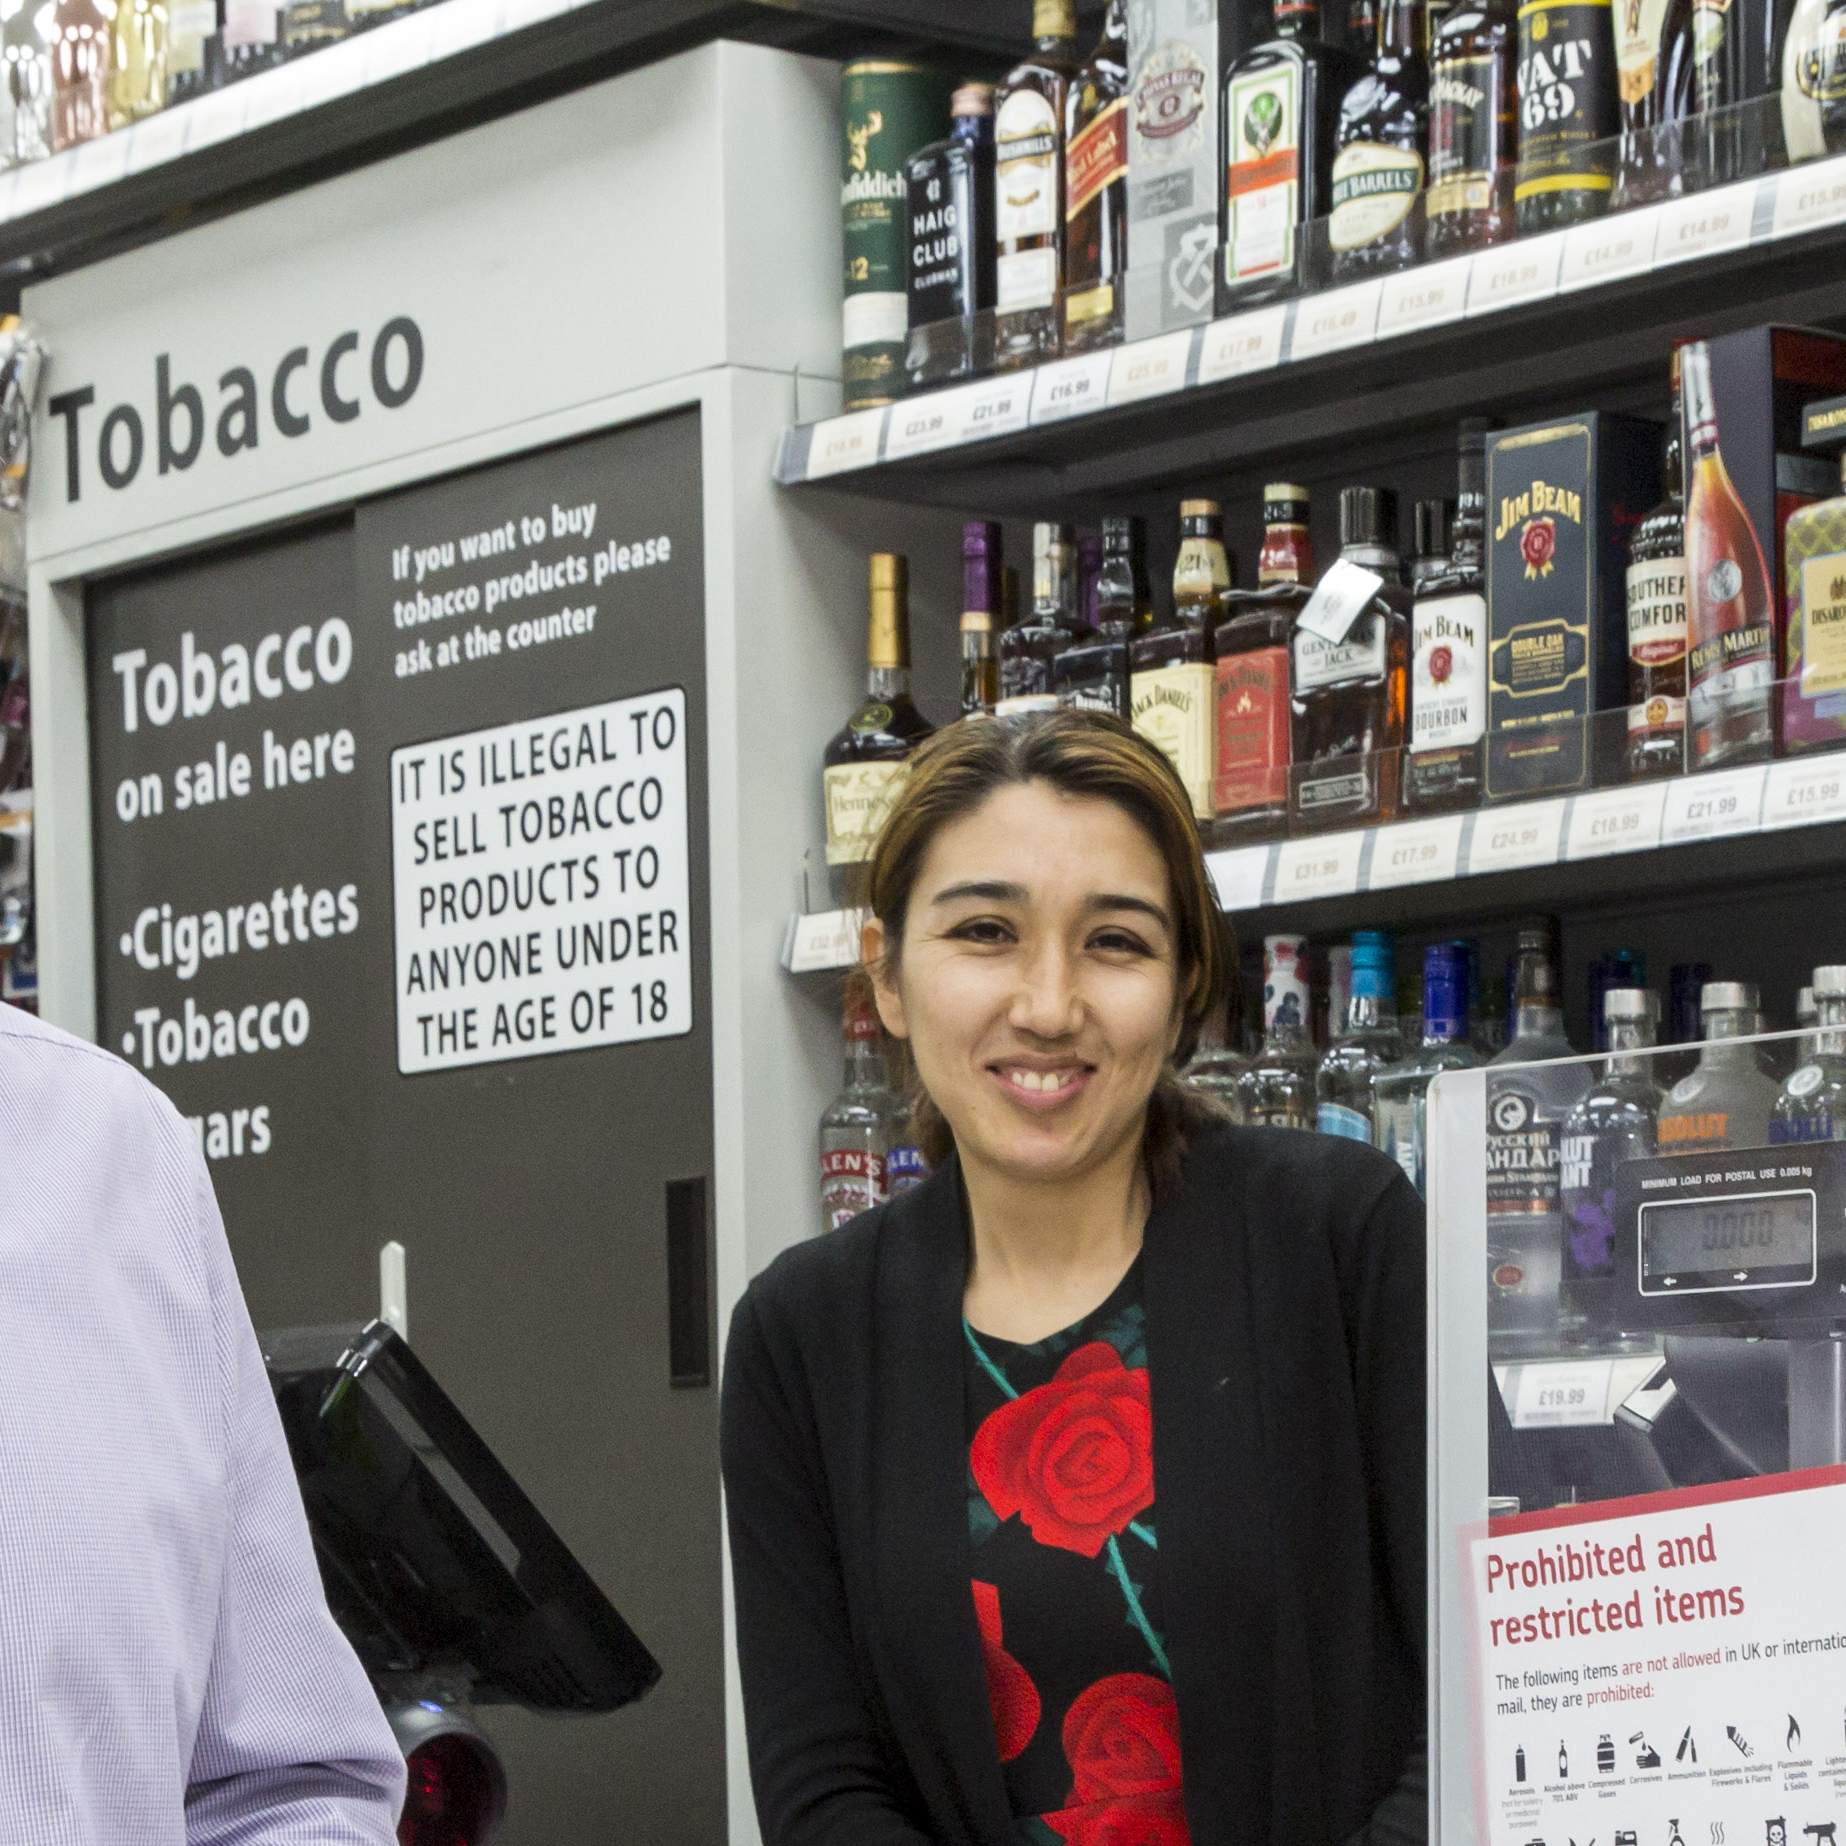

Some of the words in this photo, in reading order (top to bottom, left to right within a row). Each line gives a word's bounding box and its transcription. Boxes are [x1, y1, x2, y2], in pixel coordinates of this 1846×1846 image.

[1522, 82, 1576, 131] 69
[1349, 167, 1412, 192] BARRELS
[913, 206, 955, 235] HAIG
[913, 237, 957, 266] CLUB
[48, 315, 425, 502] Tobacco
[392, 548, 409, 579] If
[415, 536, 454, 581] you
[460, 524, 515, 567] want
[522, 515, 546, 544] to
[552, 501, 596, 541] buy
[1494, 492, 1529, 541] JIM
[1531, 480, 1581, 523] BEAM
[394, 584, 480, 627] tobacco
[485, 556, 588, 611] products
[595, 532, 671, 583] please
[395, 646, 432, 677] ask
[438, 643, 459, 665] at
[465, 630, 501, 660] the
[507, 606, 596, 651] counter
[1435, 615, 1475, 648] BEAM
[1627, 601, 1687, 634] COMFOR
[113, 617, 352, 731] Tobacco
[1414, 704, 1467, 732] BOURBON
[116, 774, 162, 821] on
[175, 743, 251, 811] sale
[265, 727, 355, 794] here
[398, 759, 427, 804] IT
[438, 751, 466, 792] IS
[480, 719, 617, 787] ILLEGAL
[631, 706, 677, 757] TO
[414, 817, 485, 864] SELL
[500, 777, 663, 848] TOBACCO
[419, 857, 599, 928] PRODUCTS
[614, 845, 659, 894] TO
[406, 931, 542, 994] ANYONE
[556, 910, 678, 967] UNDER
[418, 1014, 478, 1057] THE
[492, 997, 556, 1047] AGE
[570, 992, 613, 1031] OF
[631, 981, 667, 1023] 18
[1642, 1178, 1677, 1189] MINIMUM
[1681, 1175, 1701, 1185] LOAD
[1706, 1173, 1721, 1183] FOR
[1726, 1170, 1756, 1181] POSTAL
[1760, 1169, 1776, 1179] USE
[1780, 1167, 1800, 1177] 0.005
[1802, 1167, 1812, 1177] kg
[1488, 1534, 1644, 1593] Prohibited
[1658, 1524, 1716, 1568] and
[1491, 1590, 1642, 1646] restricted
[1655, 1584, 1745, 1624] items
[1496, 1674, 1519, 1690] The
[1524, 1667, 1579, 1689] following
[1583, 1662, 1618, 1680] items
[1622, 1661, 1642, 1676] are
[1647, 1657, 1668, 1672] not
[1672, 1650, 1721, 1670] allowed
[1725, 1647, 1737, 1663] in
[1742, 1644, 1760, 1661] UK
[1765, 1644, 1778, 1657] or
[1497, 1698, 1526, 1715] mail,
[1531, 1694, 1557, 1713] they
[1562, 1693, 1582, 1707] are
[1587, 1683, 1654, 1708] prohibited:
